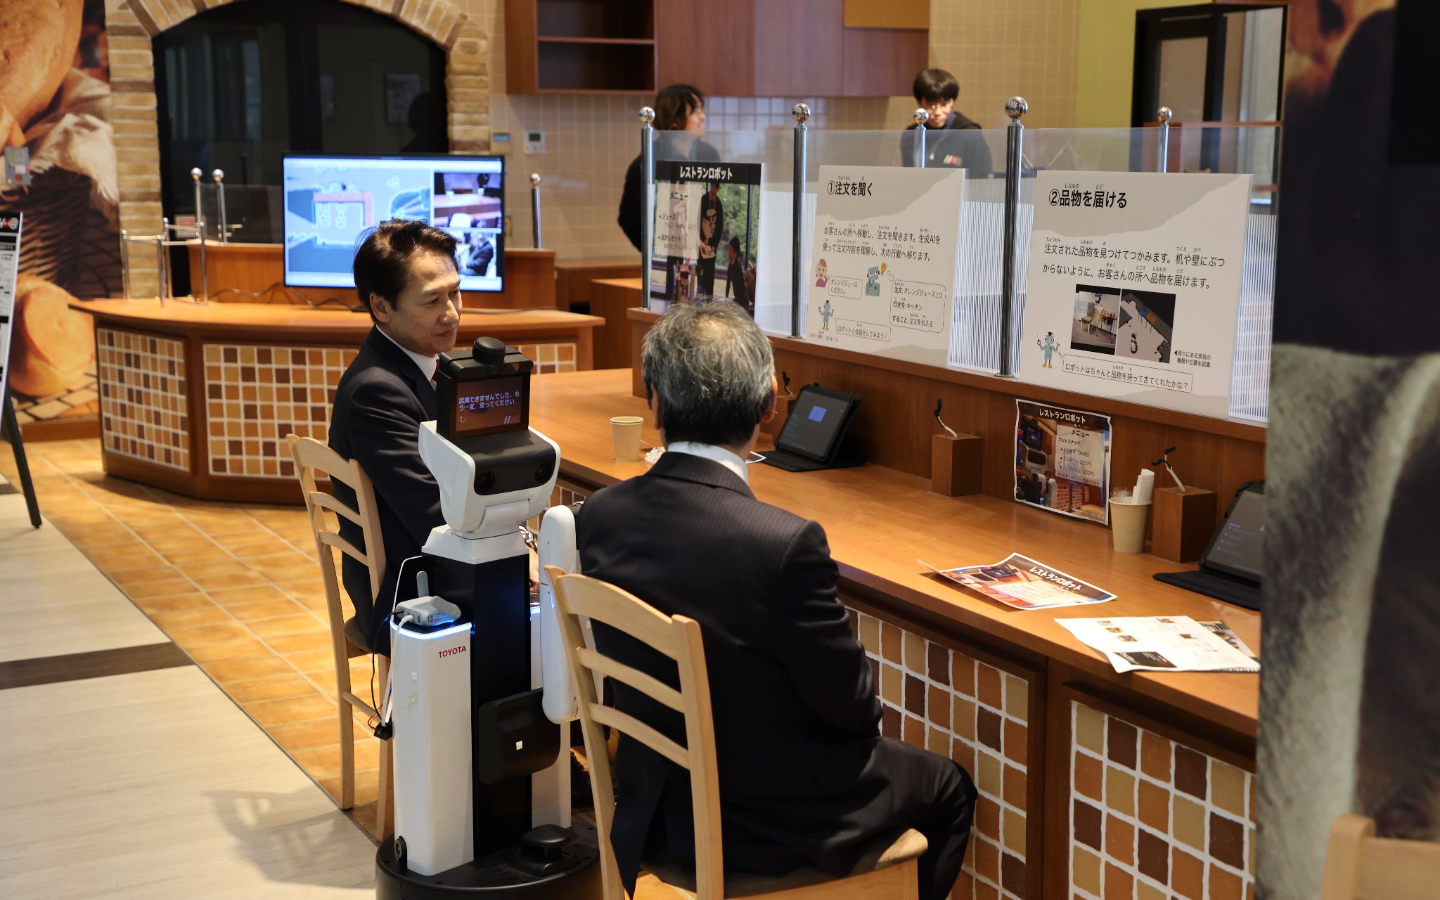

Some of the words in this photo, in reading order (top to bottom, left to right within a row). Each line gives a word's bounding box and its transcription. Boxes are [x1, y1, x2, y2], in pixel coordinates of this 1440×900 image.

[680, 166, 733, 180] レストランロボット
[670, 191, 689, 201] メニュー
[827, 180, 873, 197] ①注文を聞く
[1049, 189, 1127, 208] ②品物を届ける
[1044, 243, 1225, 267] 注文された品物を見つけてつかみます。机や壁にぶつ
[1043, 263, 1210, 289] からないように、お客さんの所へ品物を届けます。
[1065, 363, 1188, 389] ロボットはちゃんと品物を持ってきてくれたかな？
[1039, 408, 1086, 424] レストランロボット
[1028, 566, 1082, 591] レストランロボット
[438, 645, 467, 659] TOYOTA
